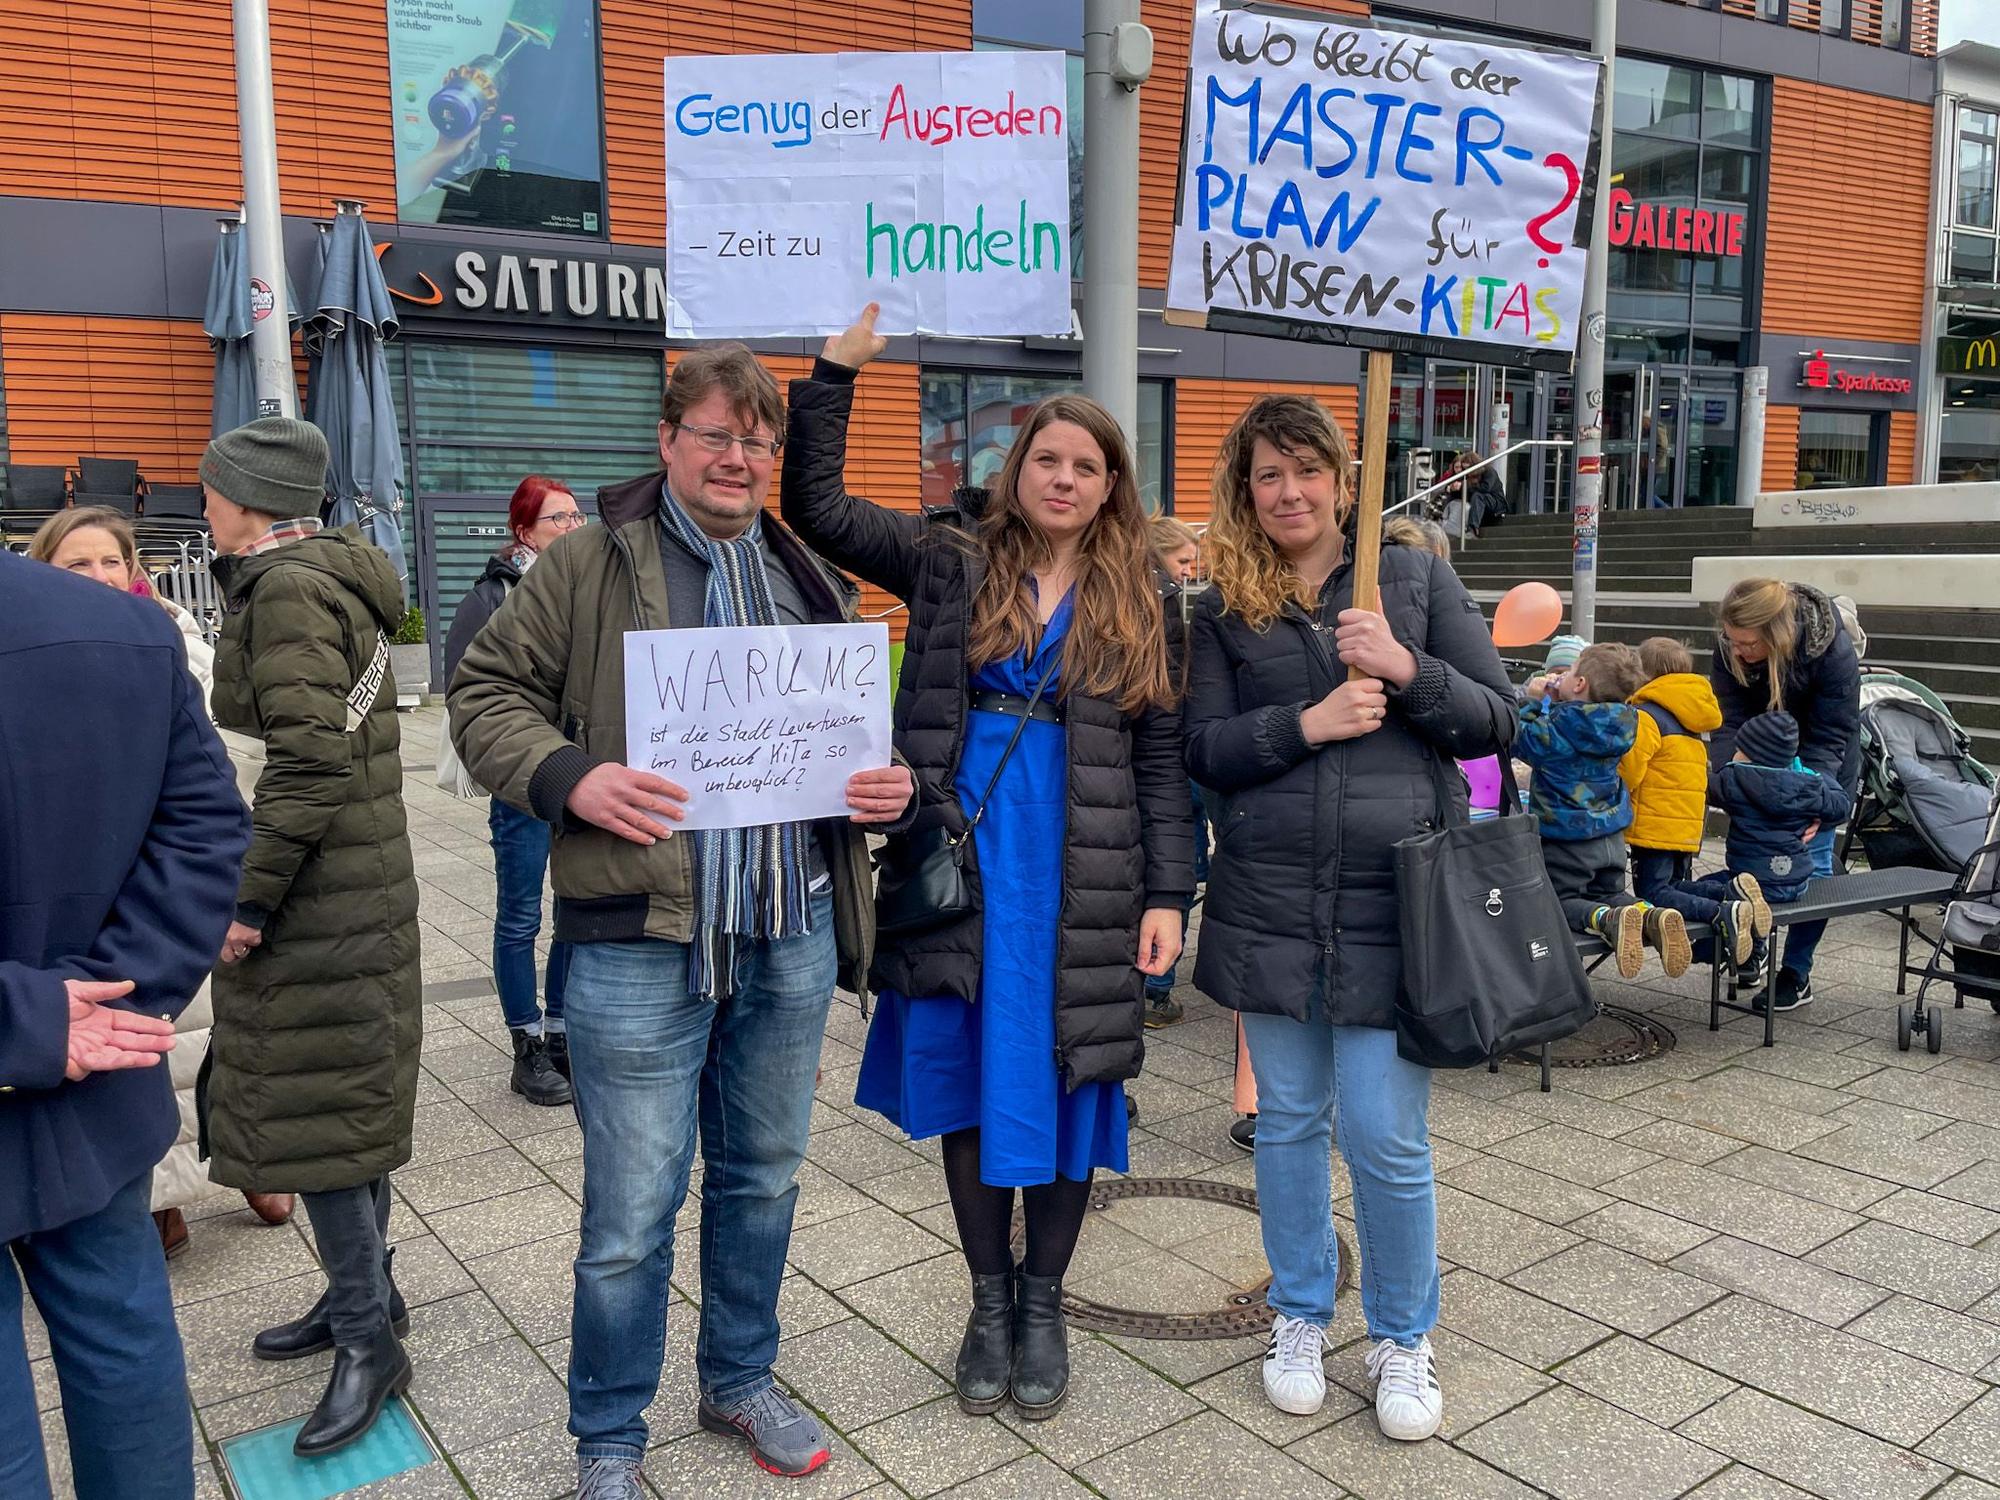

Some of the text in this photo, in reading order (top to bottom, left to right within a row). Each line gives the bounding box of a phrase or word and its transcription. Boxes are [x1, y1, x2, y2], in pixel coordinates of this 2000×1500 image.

[395, 9, 482, 26] unsichtbaren Staub
[395, 19, 432, 31] sichtbar
[426, 0, 453, 10] macht
[1217, 15, 1521, 96] Wo bleibt der
[675, 84, 1062, 148] Genug der Ausreden
[1203, 75, 1534, 186] MASTER-
[717, 231, 776, 257] Zeit
[787, 235, 821, 257] zu
[866, 199, 1061, 282] handeln
[1195, 164, 1381, 253] PLAN
[1426, 207, 1500, 266] für
[1608, 188, 1744, 256] GALERIE
[1836, 370, 1911, 394] Sparkasse
[650, 644, 876, 712] WARUM?
[650, 708, 865, 744] ist die Stadt Leverkusen
[651, 752, 676, 770] im
[691, 746, 761, 772] Bereich
